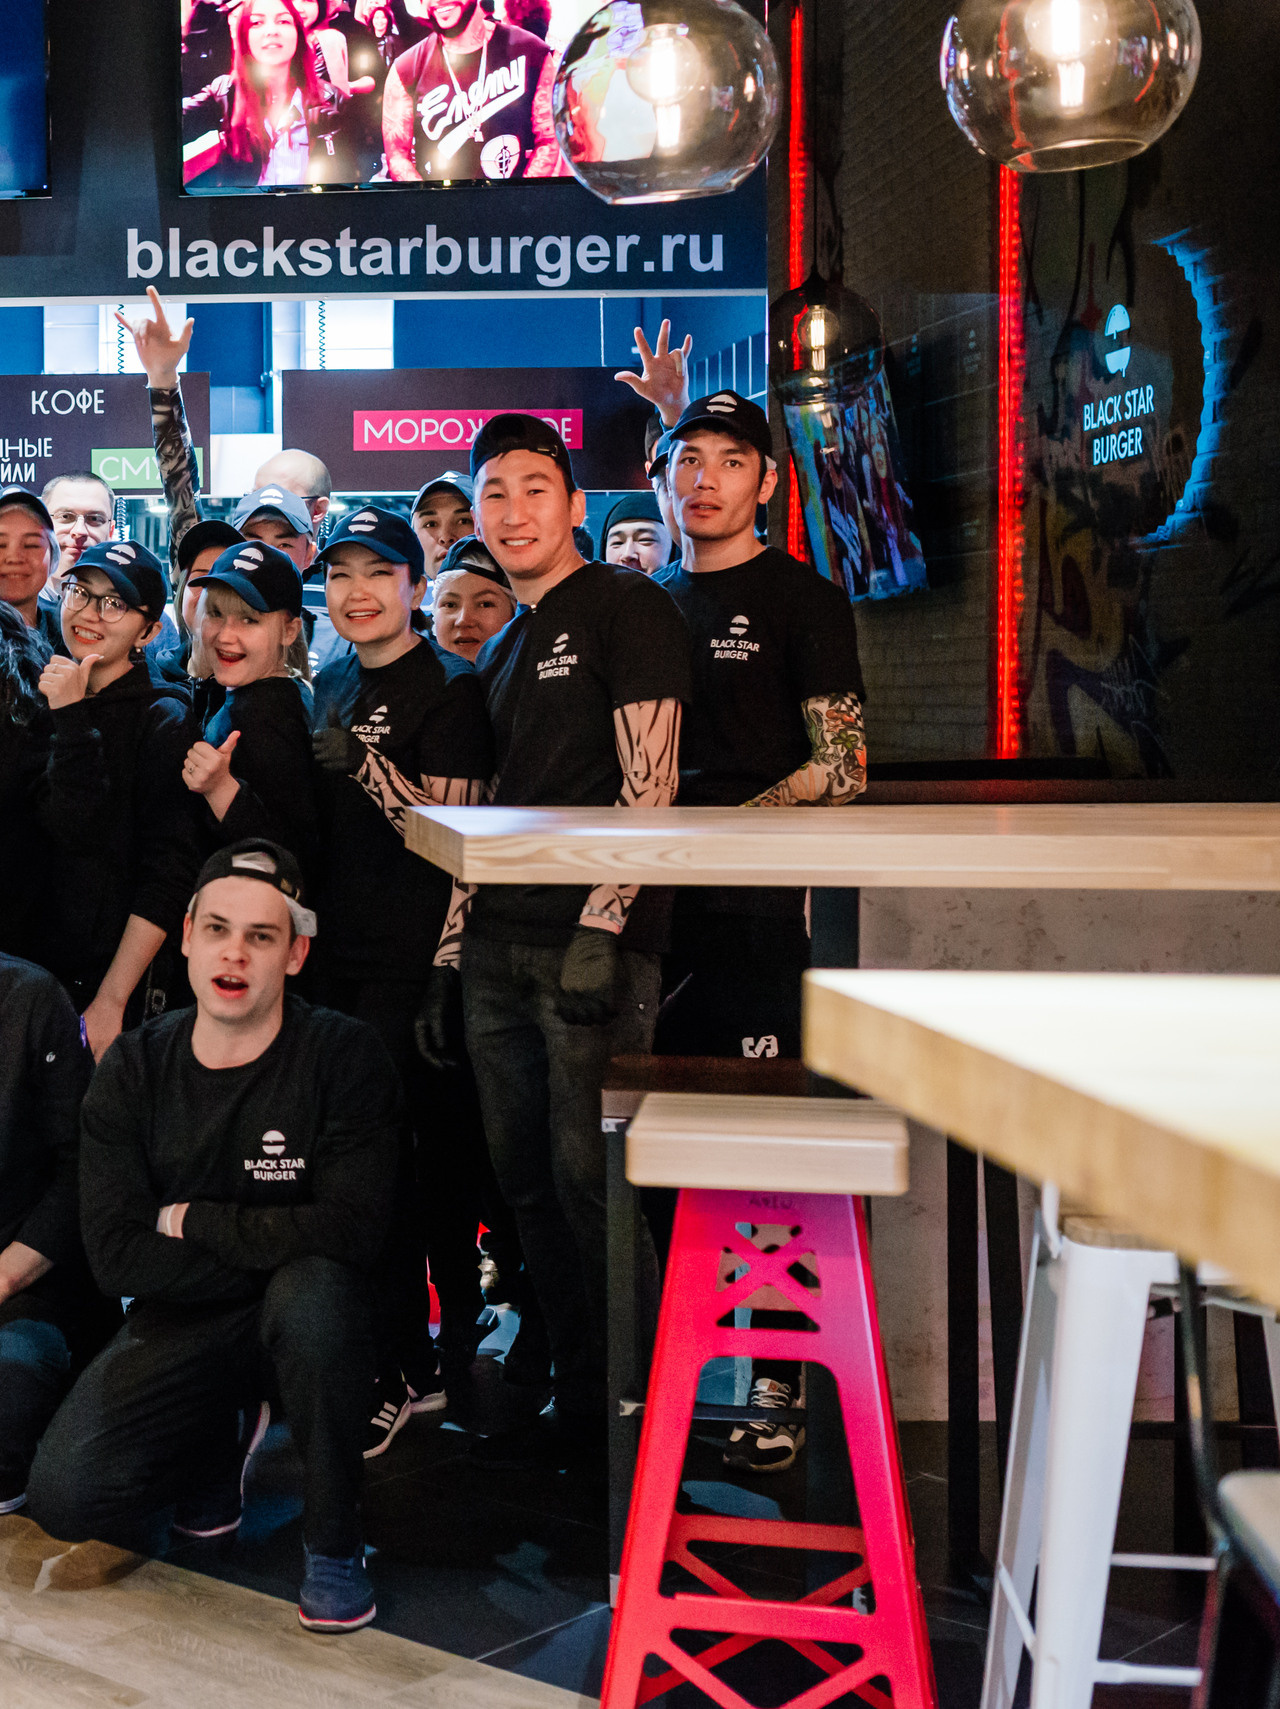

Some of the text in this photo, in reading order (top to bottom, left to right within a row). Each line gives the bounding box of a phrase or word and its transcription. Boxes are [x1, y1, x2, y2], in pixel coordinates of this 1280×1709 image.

[127, 225, 724, 287] blackstarburger.ru
[31, 387, 105, 415] КОФЕ
[1083, 384, 1155, 432] BLACK STAR
[1093, 426, 1143, 466] BURGER
[710, 639, 760, 653] BLACK STAR
[714, 649, 749, 661] BURGER
[537, 654, 579, 672] BLACK STAR
[538, 666, 570, 680] BURGER
[371, 725, 391, 735] STAR
[243, 1158, 306, 1170] BLACK STAR
[253, 1170, 297, 1181] BURGER
